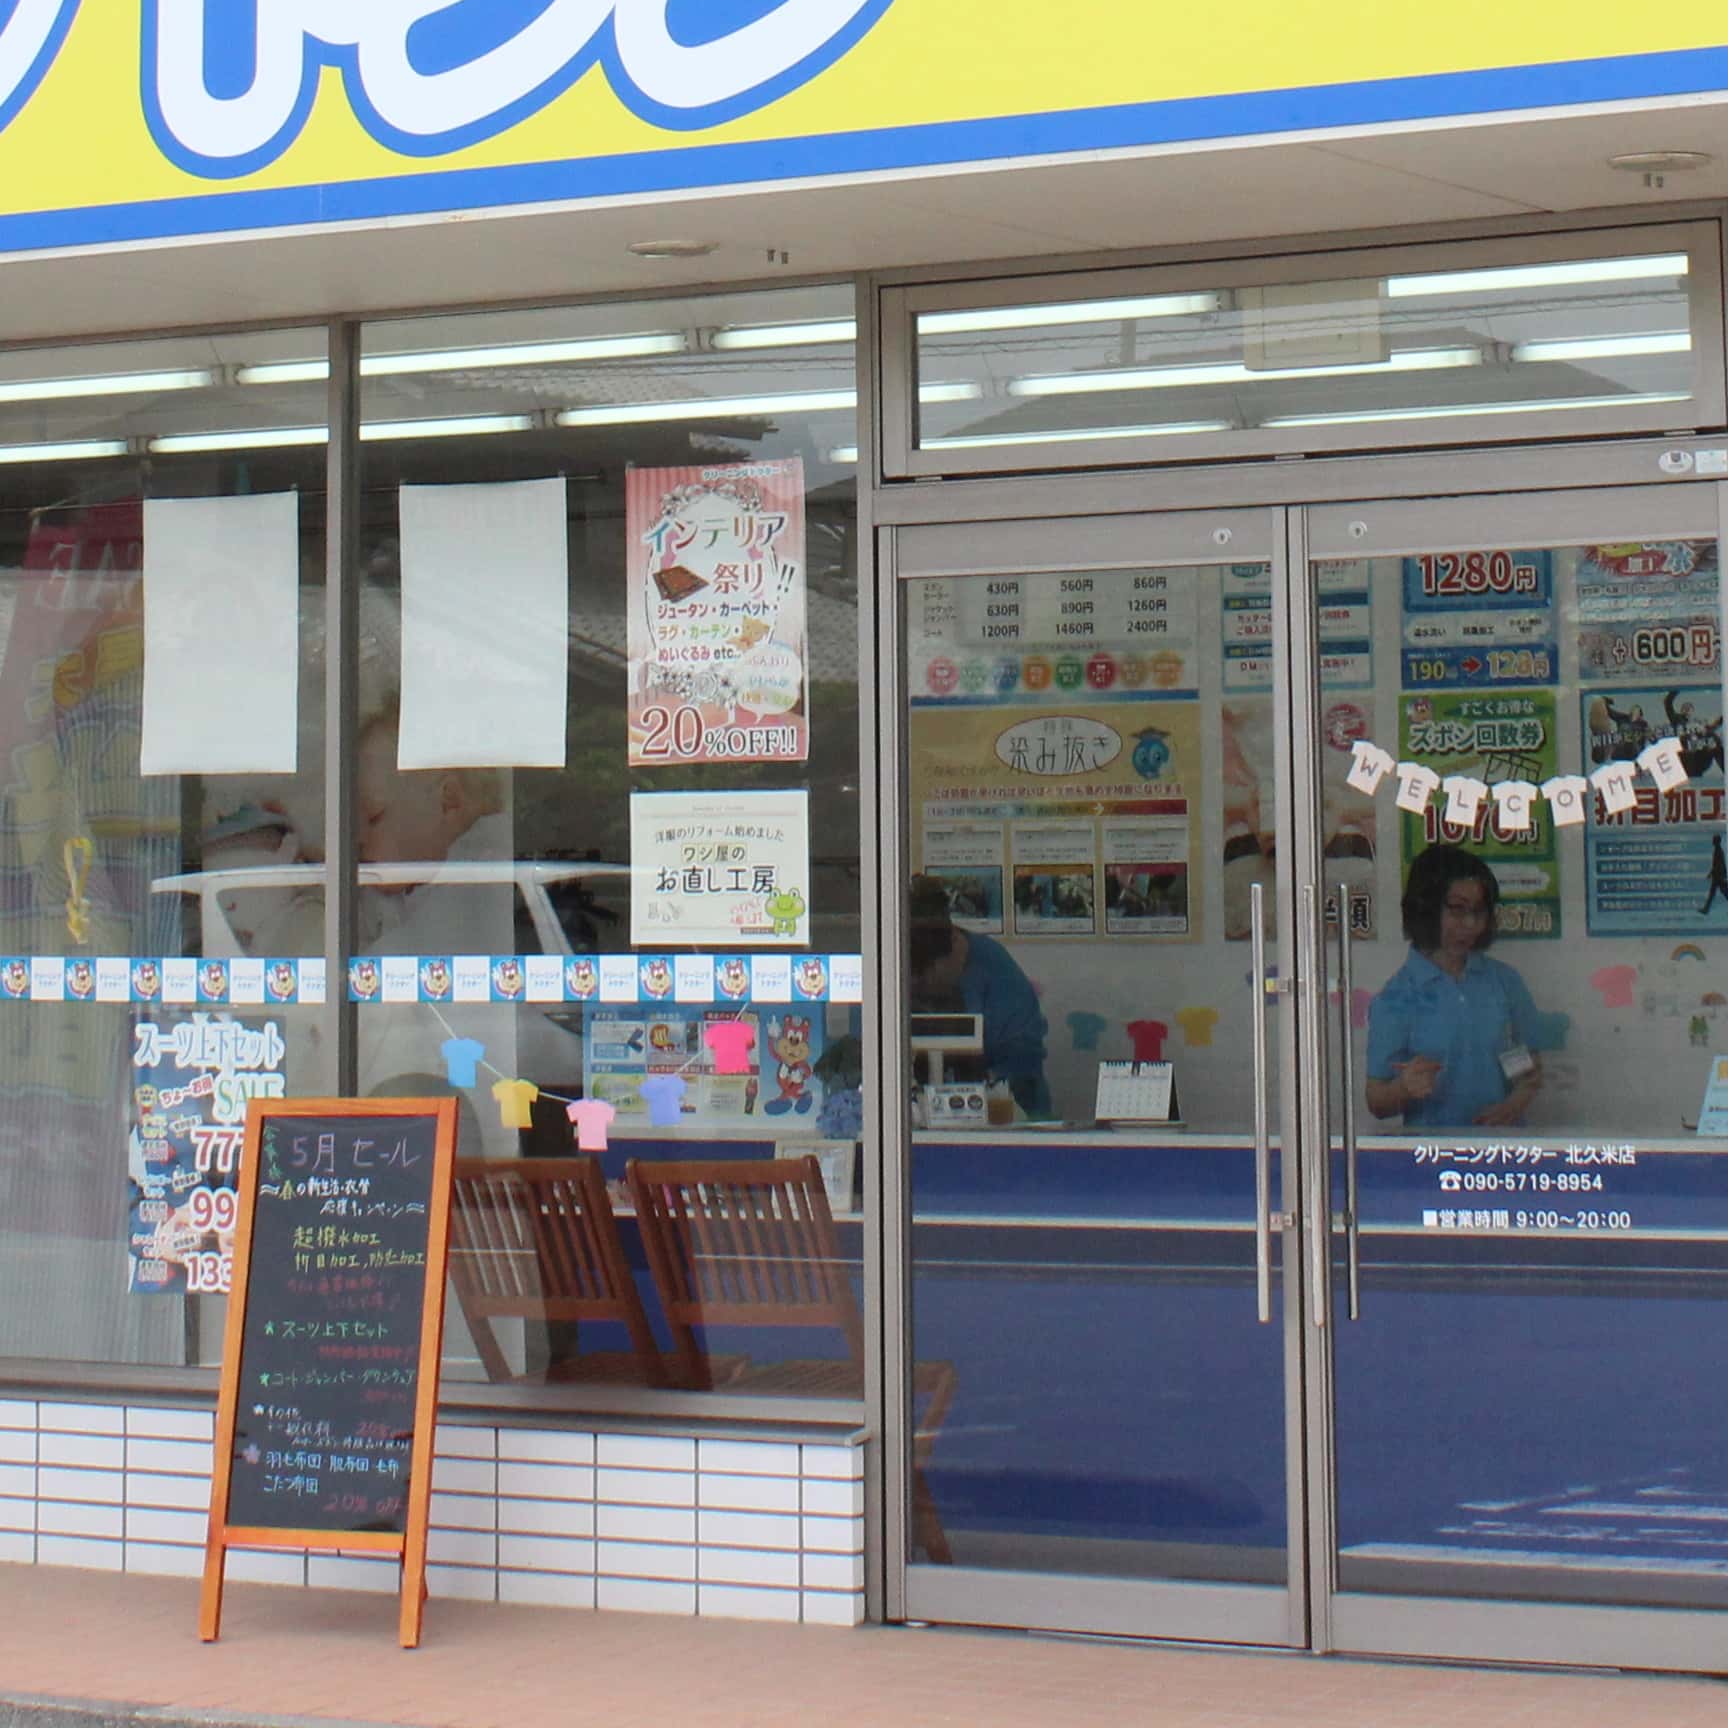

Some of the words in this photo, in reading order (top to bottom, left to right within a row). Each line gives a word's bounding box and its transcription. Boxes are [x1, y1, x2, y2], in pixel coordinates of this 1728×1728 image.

[643, 515, 786, 553] インテリア
[1419, 551, 1536, 594] 1280円
[1409, 719, 1544, 752] ズボン回数券
[1010, 735, 1111, 774] 染み抜き
[683, 845, 746, 862] ワシ屋の
[655, 865, 776, 894] お直し工房
[135, 1022, 285, 1067] スーツ上下セット
[290, 1132, 336, 1174] 5月
[352, 1133, 423, 1169] セール
[1413, 1144, 1557, 1165] クリーニングドクター
[1565, 1144, 1636, 1165] 北久米店
[1462, 1172, 1604, 1193] 090-5719-8954
[282, 1320, 389, 1340] スーツ上下セット
